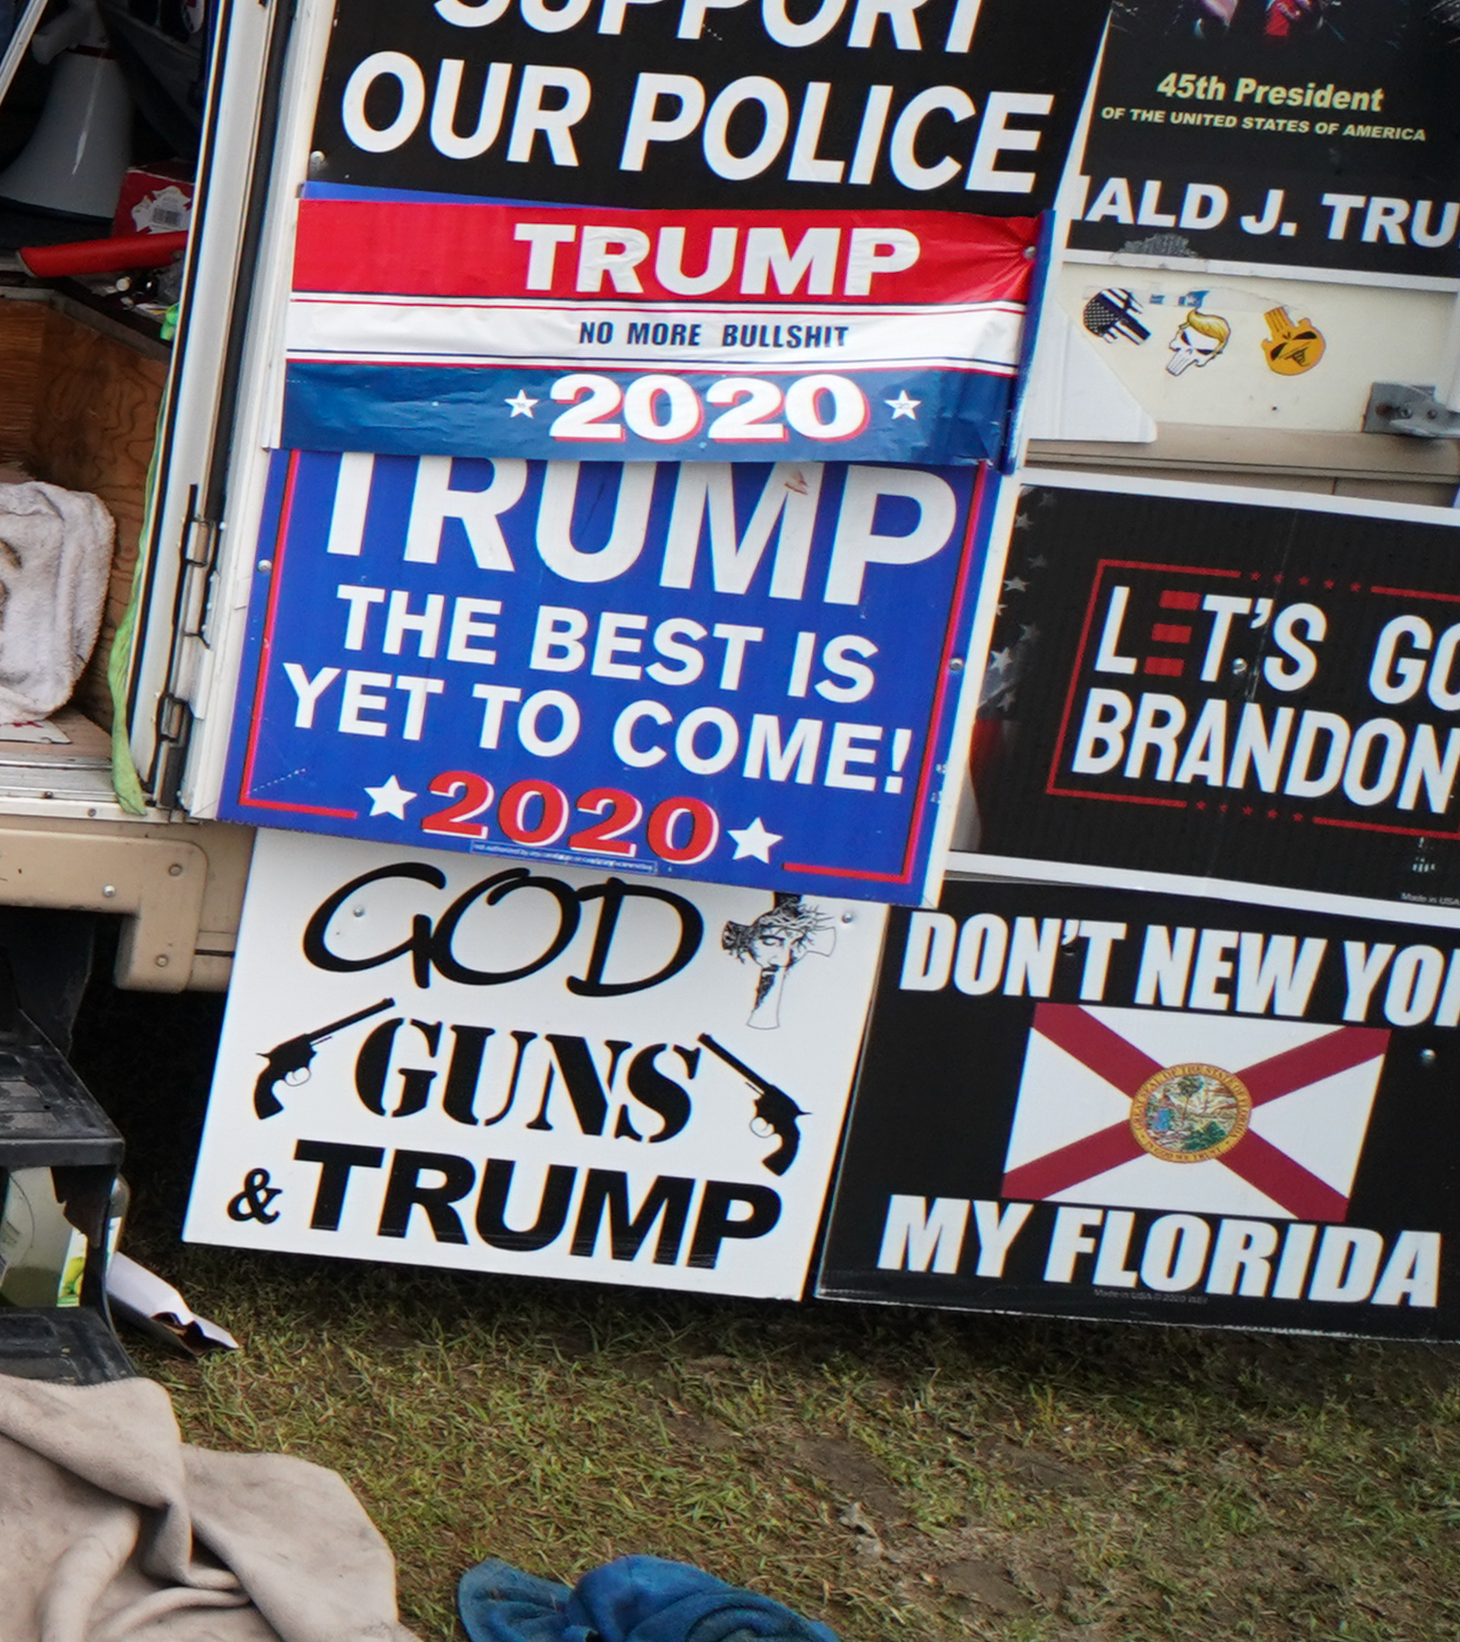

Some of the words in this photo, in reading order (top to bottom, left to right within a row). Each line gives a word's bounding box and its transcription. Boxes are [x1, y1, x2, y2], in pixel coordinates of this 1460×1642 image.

[341, 49, 592, 167] OUR
[618, 70, 1055, 194] POLICE
[1102, 107, 1125, 120] OF
[1130, 109, 1165, 123] THE
[1170, 111, 1237, 129] UNITED
[1241, 115, 1310, 134] STATES
[1315, 119, 1340, 135] OF
[1344, 123, 1427, 142] AMERICA
[1157, 73, 1227, 102] 45th
[1234, 77, 1385, 113] President
[513, 220, 921, 298] TRUMP
[578, 319, 615, 345] NO
[626, 321, 702, 347] MORE
[722, 324, 849, 350] BULLSHIT
[548, 371, 869, 443] 2020
[326, 452, 958, 606] TRUMP
[336, 582, 505, 665] THE
[528, 603, 762, 692] BEST
[786, 630, 879, 703] IS
[1094, 585, 1329, 694] LET'S
[1368, 614, 1460, 713] G
[282, 661, 442, 742] YET
[470, 682, 581, 758] TO
[612, 698, 914, 796] COME!
[1071, 689, 1460, 815] BRANDON
[423, 769, 720, 865] 2020
[302, 861, 705, 998] GOD
[898, 910, 1128, 1001] DON'T
[1133, 924, 1329, 1018] NEW
[354, 1016, 702, 1145] GUNS
[226, 1167, 282, 1225] &
[292, 1138, 783, 1271] TRUMP
[876, 1194, 1035, 1279] MY
[1043, 1205, 1443, 1309] FLORIDA
